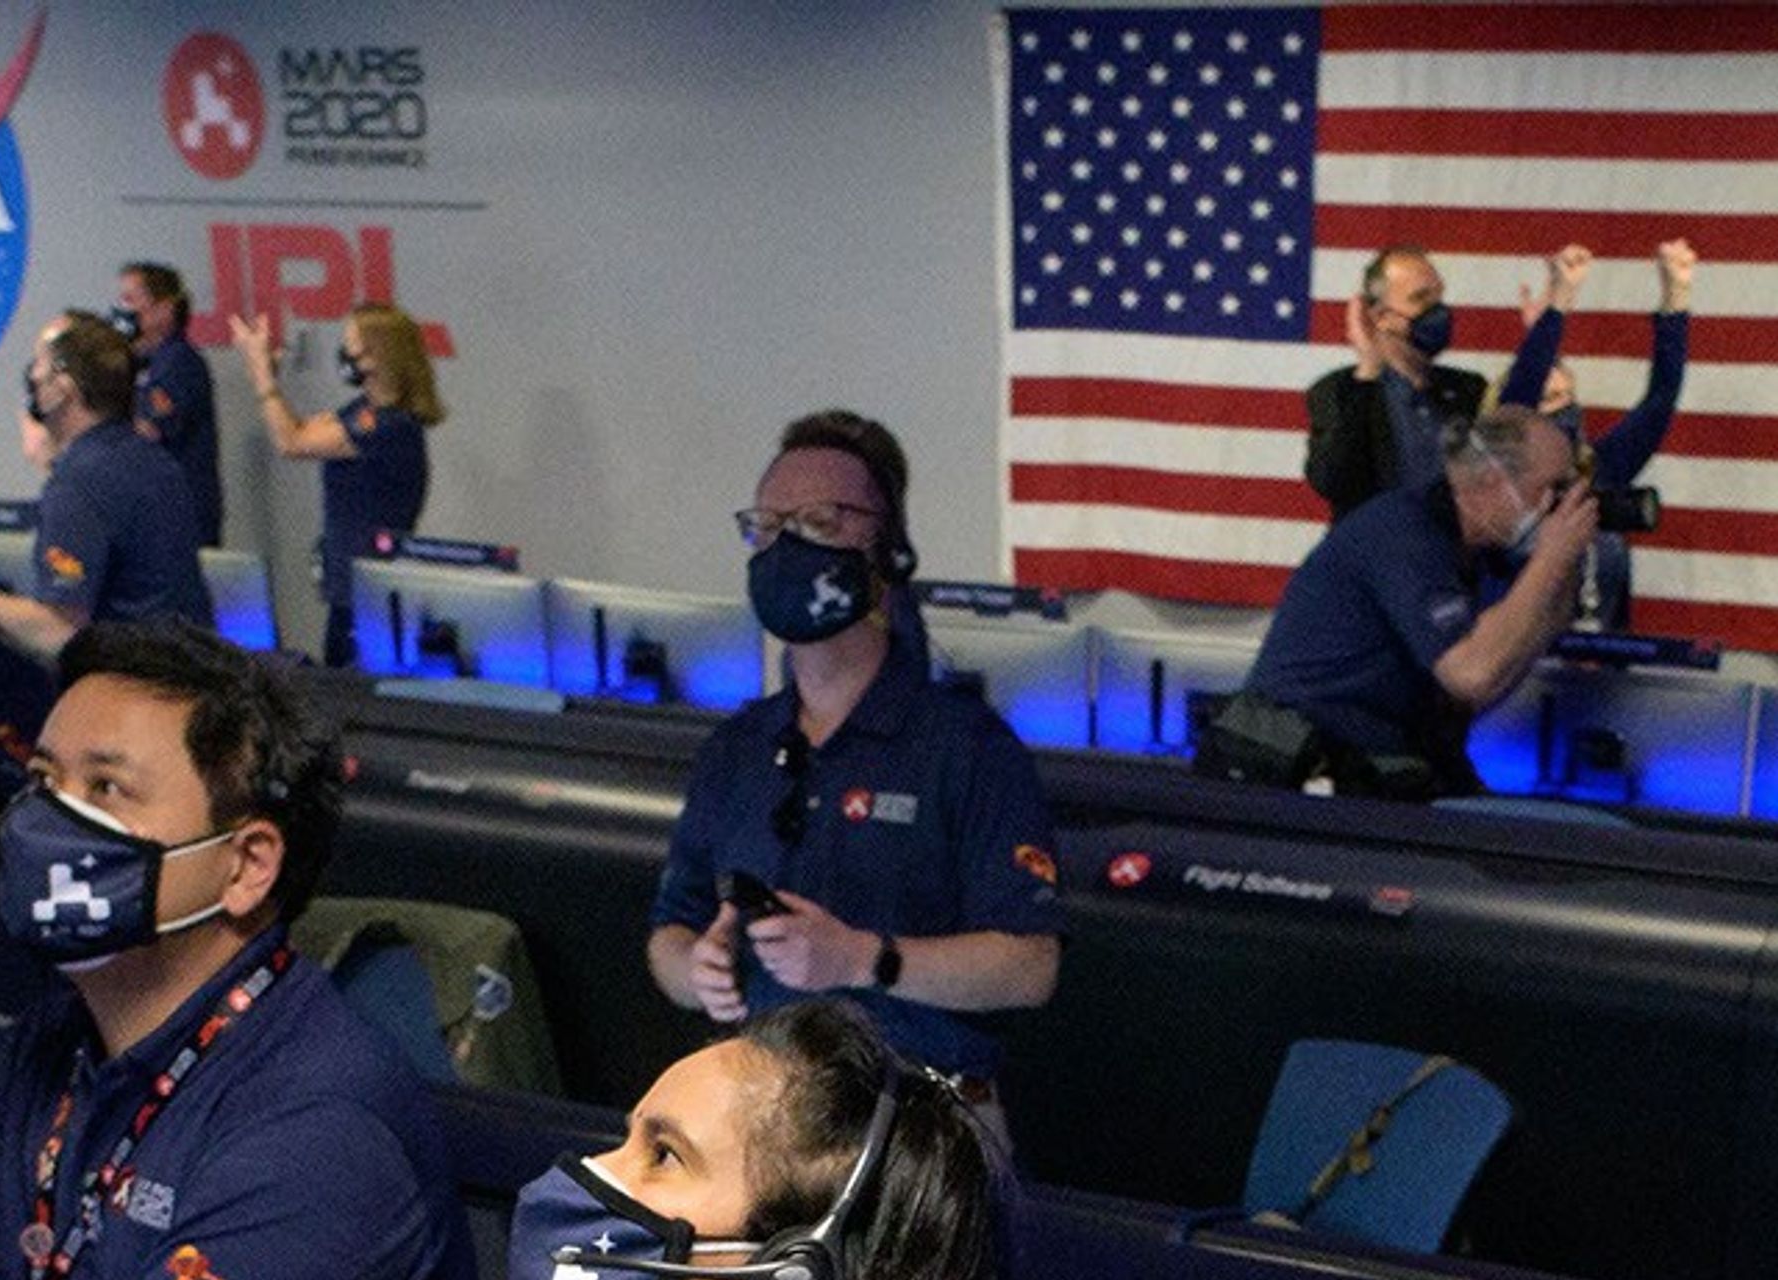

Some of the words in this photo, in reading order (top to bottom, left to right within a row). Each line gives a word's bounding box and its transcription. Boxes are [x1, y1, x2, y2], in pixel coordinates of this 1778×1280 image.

[282, 47, 425, 84] MARS
[284, 91, 427, 138] 2020
[188, 223, 456, 357] JPL
